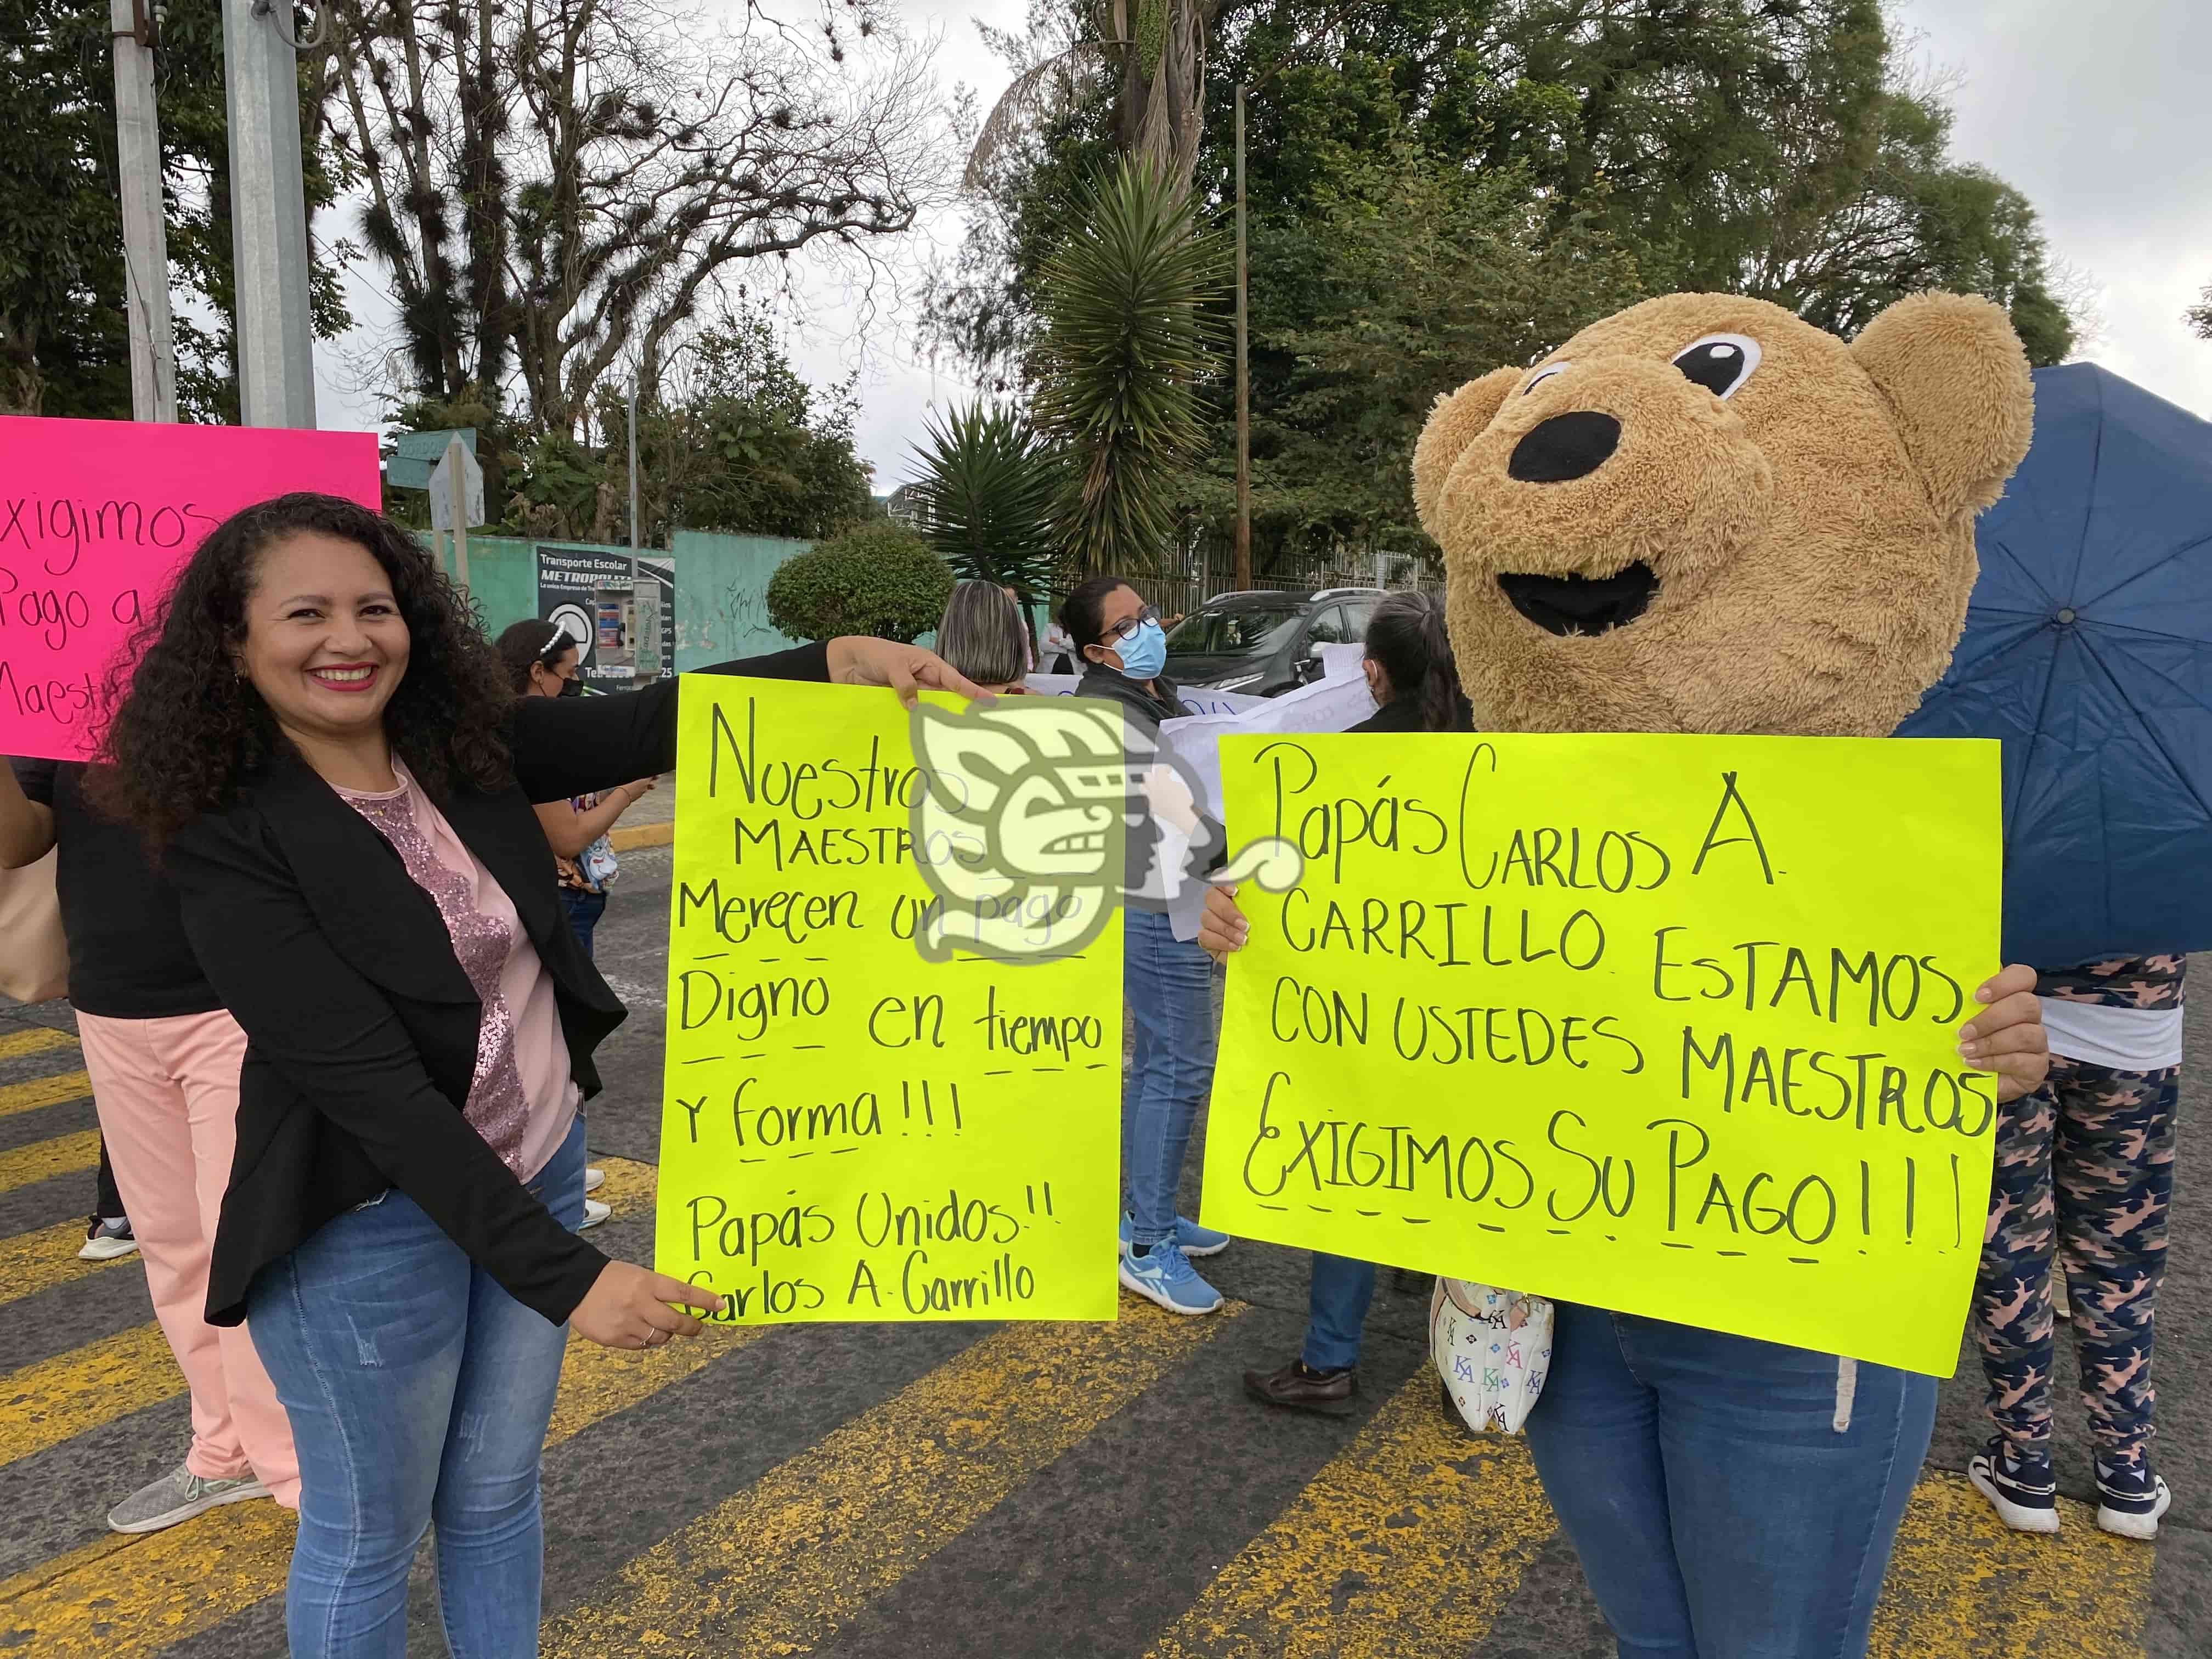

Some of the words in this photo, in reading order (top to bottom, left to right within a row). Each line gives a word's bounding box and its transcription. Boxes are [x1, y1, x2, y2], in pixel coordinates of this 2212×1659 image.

[540, 554, 592, 568] Transporte
[594, 558, 627, 571] Escolar
[709, 697, 969, 820] Nuestros
[735, 816, 986, 872] MAESTROS
[1254, 742, 1448, 884] Papás
[1460, 743, 1671, 893] CARLOS
[679, 878, 864, 944] Merecen
[974, 894, 1083, 945] pago
[679, 970, 829, 1041] Digno
[868, 995, 945, 1048] en
[974, 985, 1102, 1062] tiempo
[1272, 977, 1368, 1046] CON
[1393, 997, 1644, 1074] USTEDES
[1681, 1026, 1994, 1137] MAESTROS
[1243, 1071, 1534, 1210] EXIGIMOS
[686, 1190, 834, 1266] Papás
[902, 1250, 1034, 1314] Carrillo
